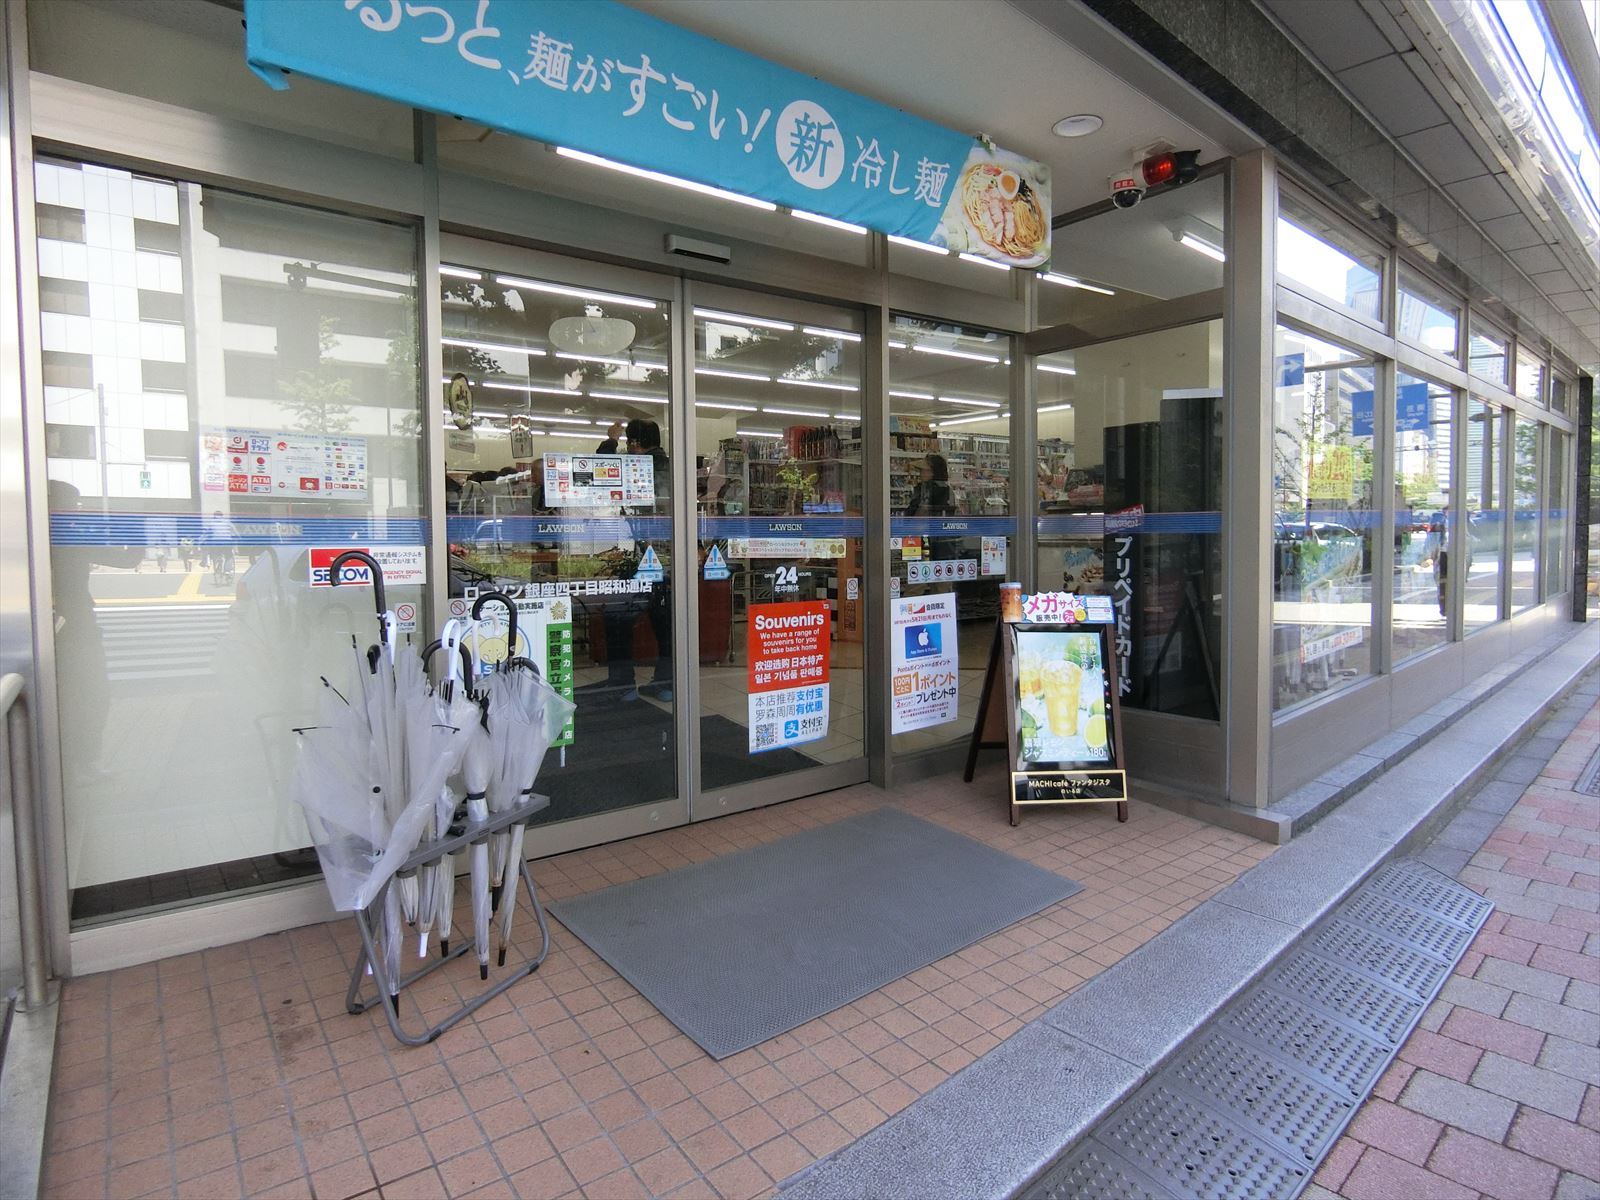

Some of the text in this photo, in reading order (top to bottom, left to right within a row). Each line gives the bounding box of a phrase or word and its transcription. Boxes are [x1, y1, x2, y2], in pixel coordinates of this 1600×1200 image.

[787, 112, 837, 178] 新
[851, 136, 951, 209] 冷し麺
[538, 523, 586, 533] LAWSON
[768, 523, 803, 531] LAWSON
[942, 522, 969, 530] LAWSON
[775, 566, 799, 585] 24
[774, 584, 800, 593] 年中無休
[755, 612, 824, 630] Souvenirs
[1113, 536, 1134, 697] プリペイドカード
[760, 632, 771, 640] We
[794, 629, 811, 637] range
[763, 638, 794, 647] souvenirs
[806, 637, 817, 645] you
[755, 667, 823, 684] 일본 기념품 판매중
[912, 671, 956, 691] 1ポイント
[916, 686, 957, 704] プレゼント中
[800, 716, 824, 730] 支付宝
[1090, 748, 1104, 757] 180
[1070, 778, 1111, 786] ファンタジスタ
